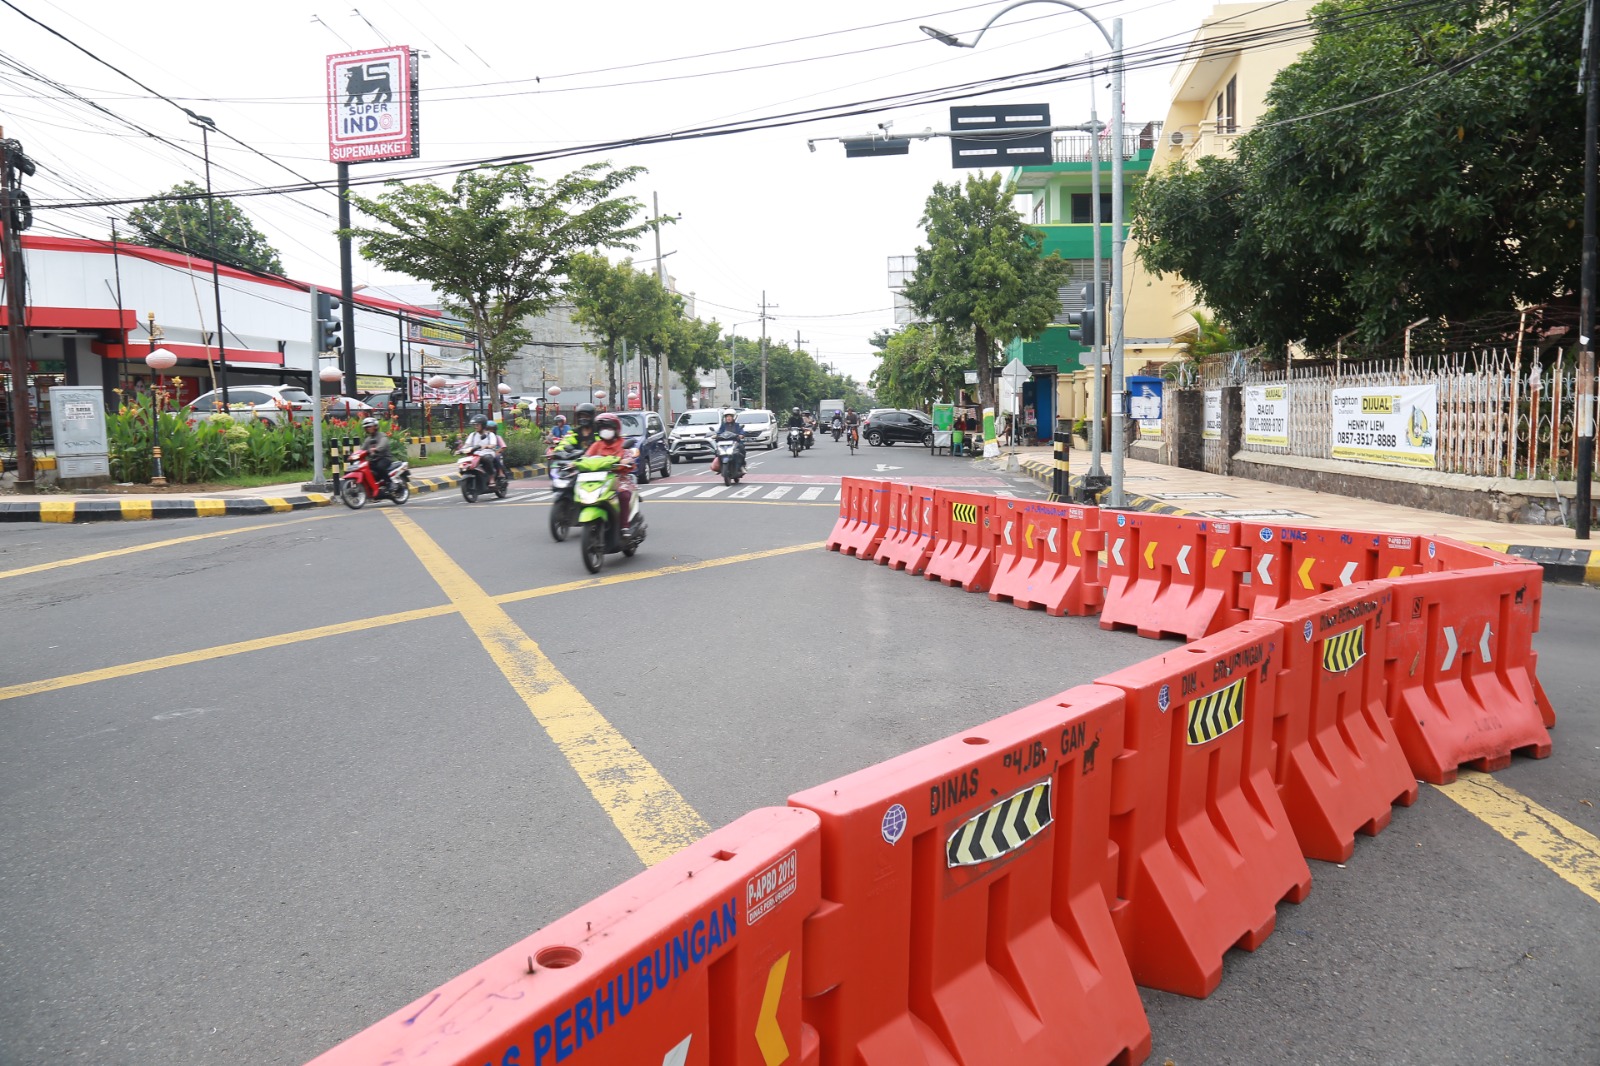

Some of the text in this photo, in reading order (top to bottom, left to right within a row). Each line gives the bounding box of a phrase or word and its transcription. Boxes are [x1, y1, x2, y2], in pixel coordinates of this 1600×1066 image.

[349, 103, 388, 116] SUPER
[343, 113, 393, 134] INDO
[332, 141, 408, 160] SUPERMARKET
[1257, 404, 1275, 415] BAGIO
[1334, 395, 1359, 408] Brighton
[1362, 397, 1390, 411] DIJUAL
[1347, 420, 1385, 431] HENRY LIEM
[1337, 431, 1397, 447] 0857-3517-8888
[930, 767, 980, 816] DINAS
[748, 854, 795, 907] P-APBD 2019
[749, 905, 763, 922] DINAS
[533, 897, 737, 1066] PERHUBUNGAN
